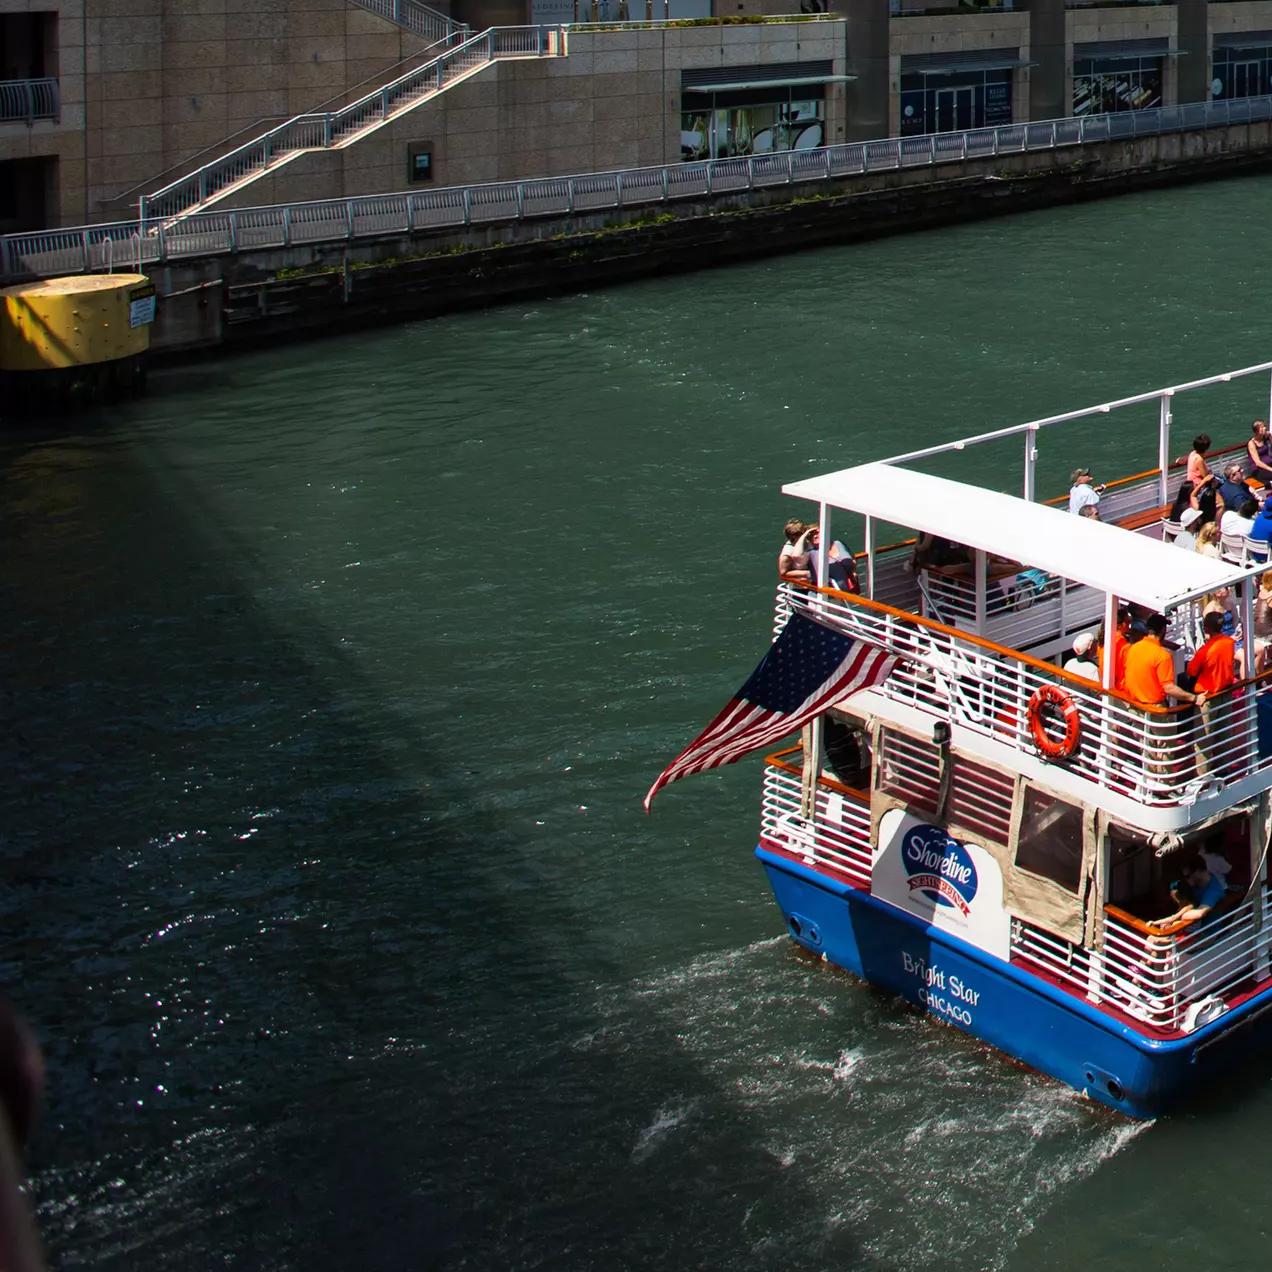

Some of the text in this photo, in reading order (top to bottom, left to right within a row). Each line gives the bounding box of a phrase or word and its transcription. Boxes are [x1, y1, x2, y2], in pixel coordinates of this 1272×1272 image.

[907, 836, 972, 884] Shoreline
[911, 875, 966, 912] SIGHTSEEING
[902, 950, 980, 1007] Bright Star
[918, 987, 972, 1025] CHICAGO
